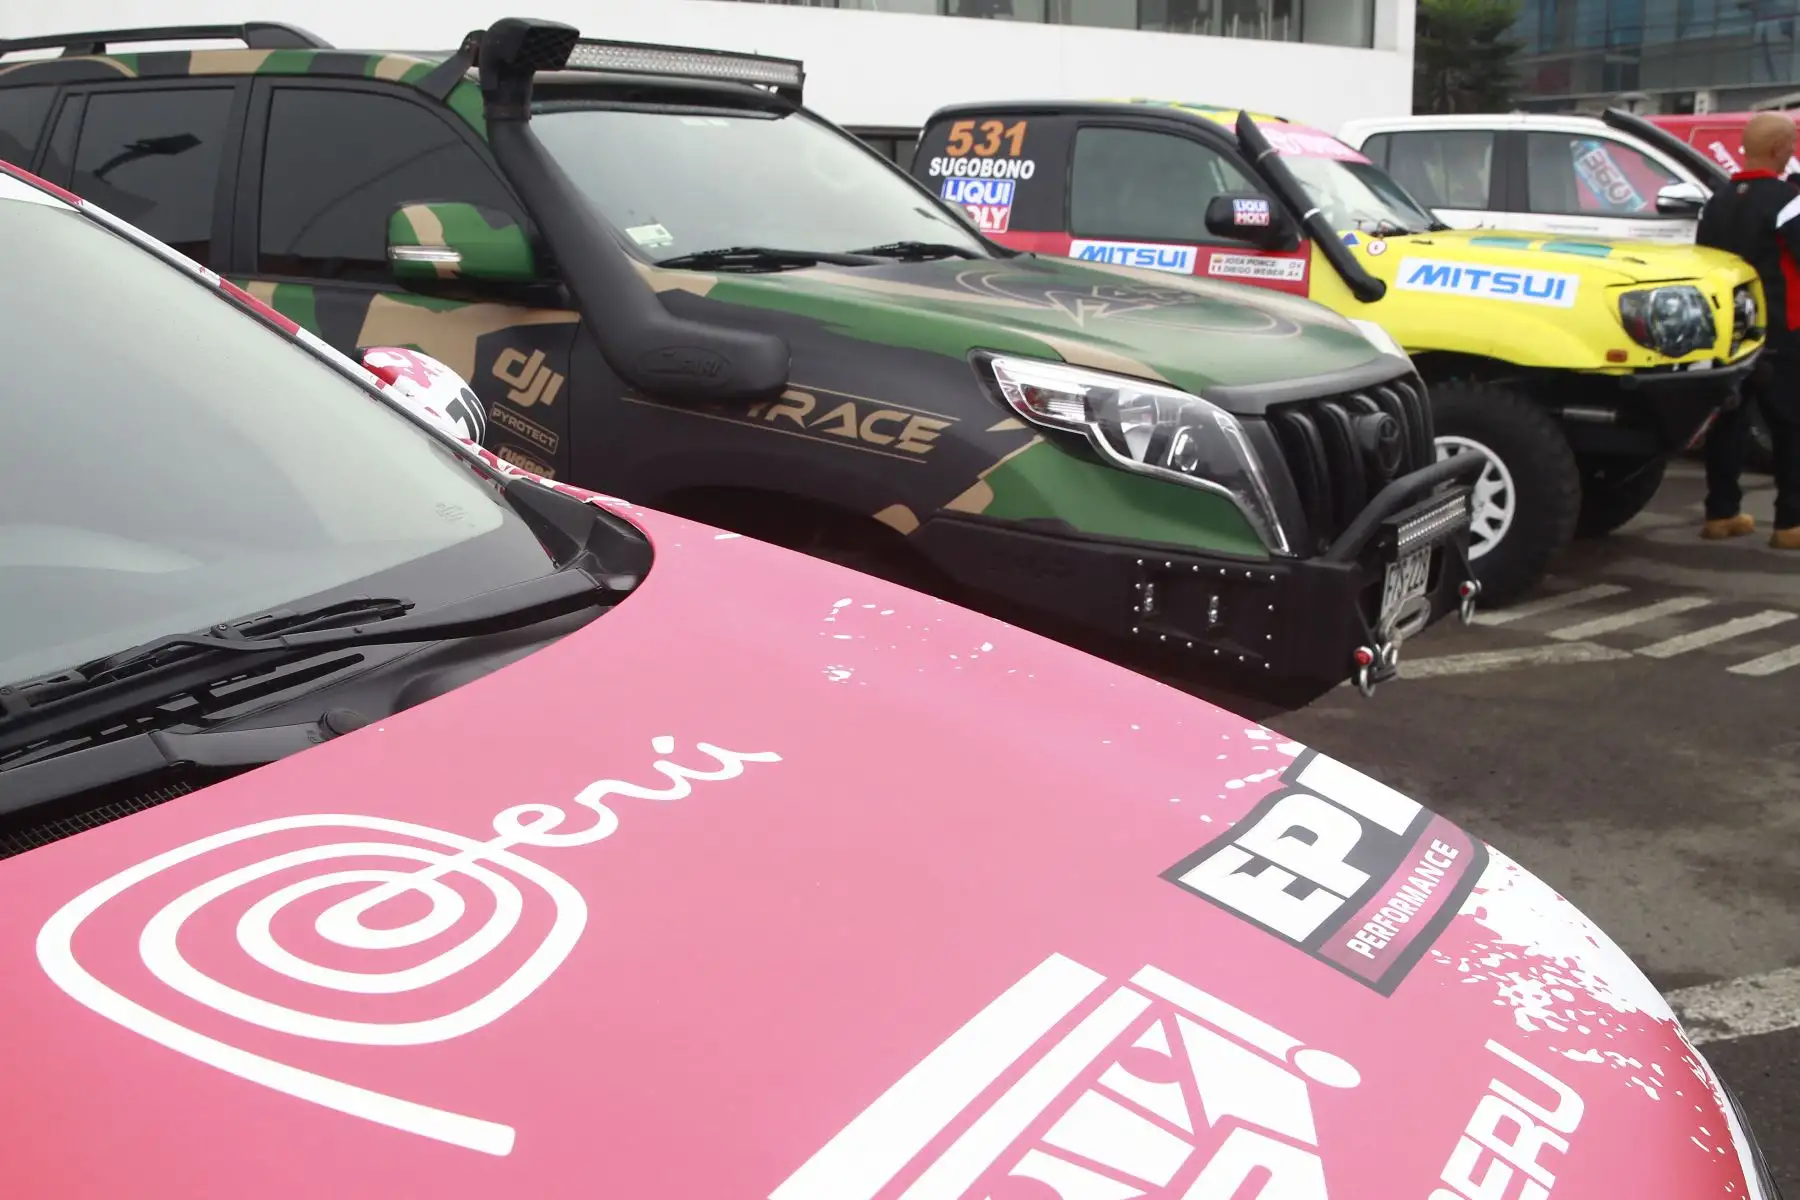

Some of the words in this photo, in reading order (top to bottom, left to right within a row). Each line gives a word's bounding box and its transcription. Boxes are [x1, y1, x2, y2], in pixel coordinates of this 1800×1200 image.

[945, 120, 1028, 157] 531
[929, 157, 1036, 180] SUGOBONO
[944, 180, 1011, 205] LIQUI
[1233, 199, 1269, 213] LIQUI
[1234, 213, 1269, 226] MOLY
[1078, 245, 1188, 269] MITSUI
[1406, 264, 1567, 301] MITSUI
[493, 408, 556, 446] PYROTECT
[1177, 752, 1425, 944] EPI
[1345, 838, 1460, 960] PERFORMANCE
[1427, 1037, 1585, 1200] ERU
